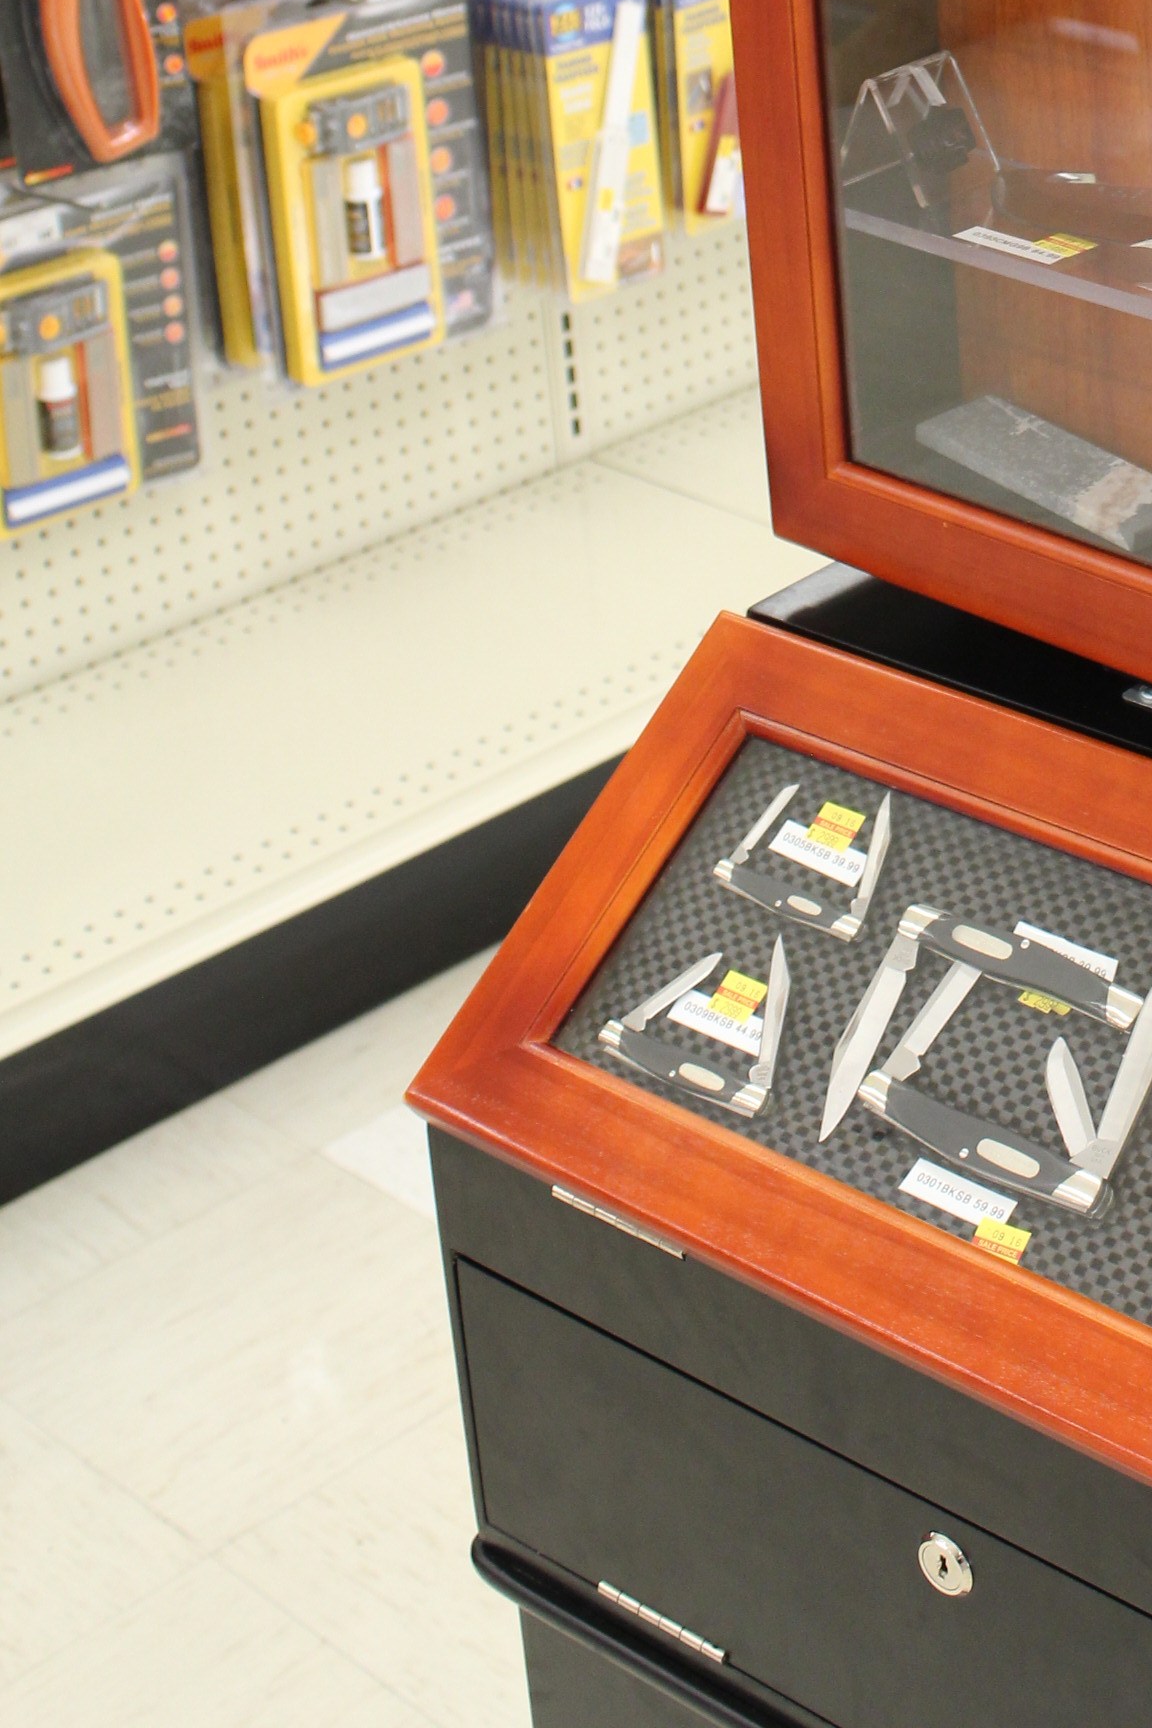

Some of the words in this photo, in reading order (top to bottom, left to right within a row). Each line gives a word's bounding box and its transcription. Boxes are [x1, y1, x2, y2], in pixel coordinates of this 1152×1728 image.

[783, 832, 831, 860] 0305BKSB
[832, 854, 860, 873] 39.99
[684, 1001, 734, 1029] 0309BKSB
[736, 1024, 762, 1041] 44.99
[916, 1172, 972, 1205] 0301BKSB
[973, 1199, 1005, 1219] 59.99
[978, 1237, 997, 1251] SALE
[996, 1245, 1017, 1258] PRICE
